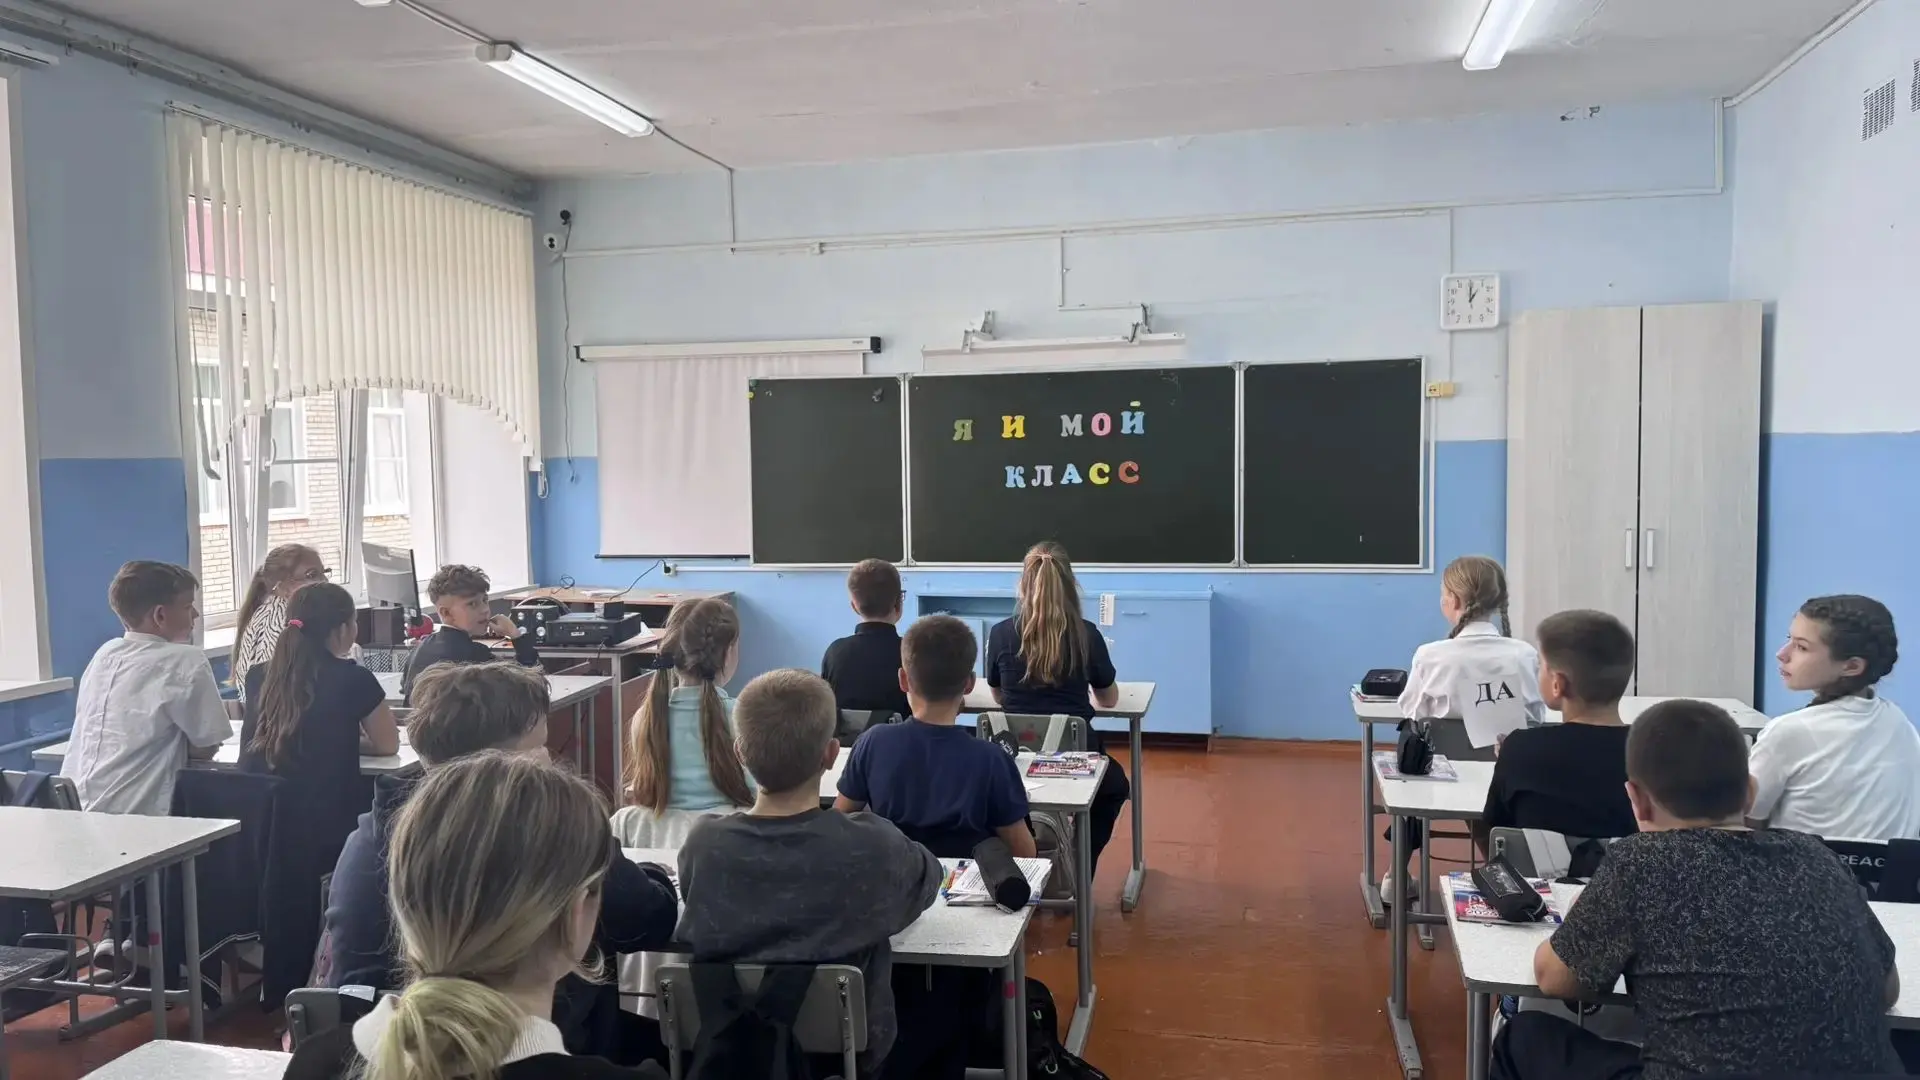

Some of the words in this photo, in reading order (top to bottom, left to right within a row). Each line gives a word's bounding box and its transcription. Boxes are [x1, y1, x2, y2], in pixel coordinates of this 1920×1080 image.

[953, 419, 973, 441] Я
[1001, 415, 1026, 438] И
[1060, 401, 1145, 437] МОЙ
[1005, 461, 1140, 488] КЛАСС
[1475, 681, 1516, 707] ДА
